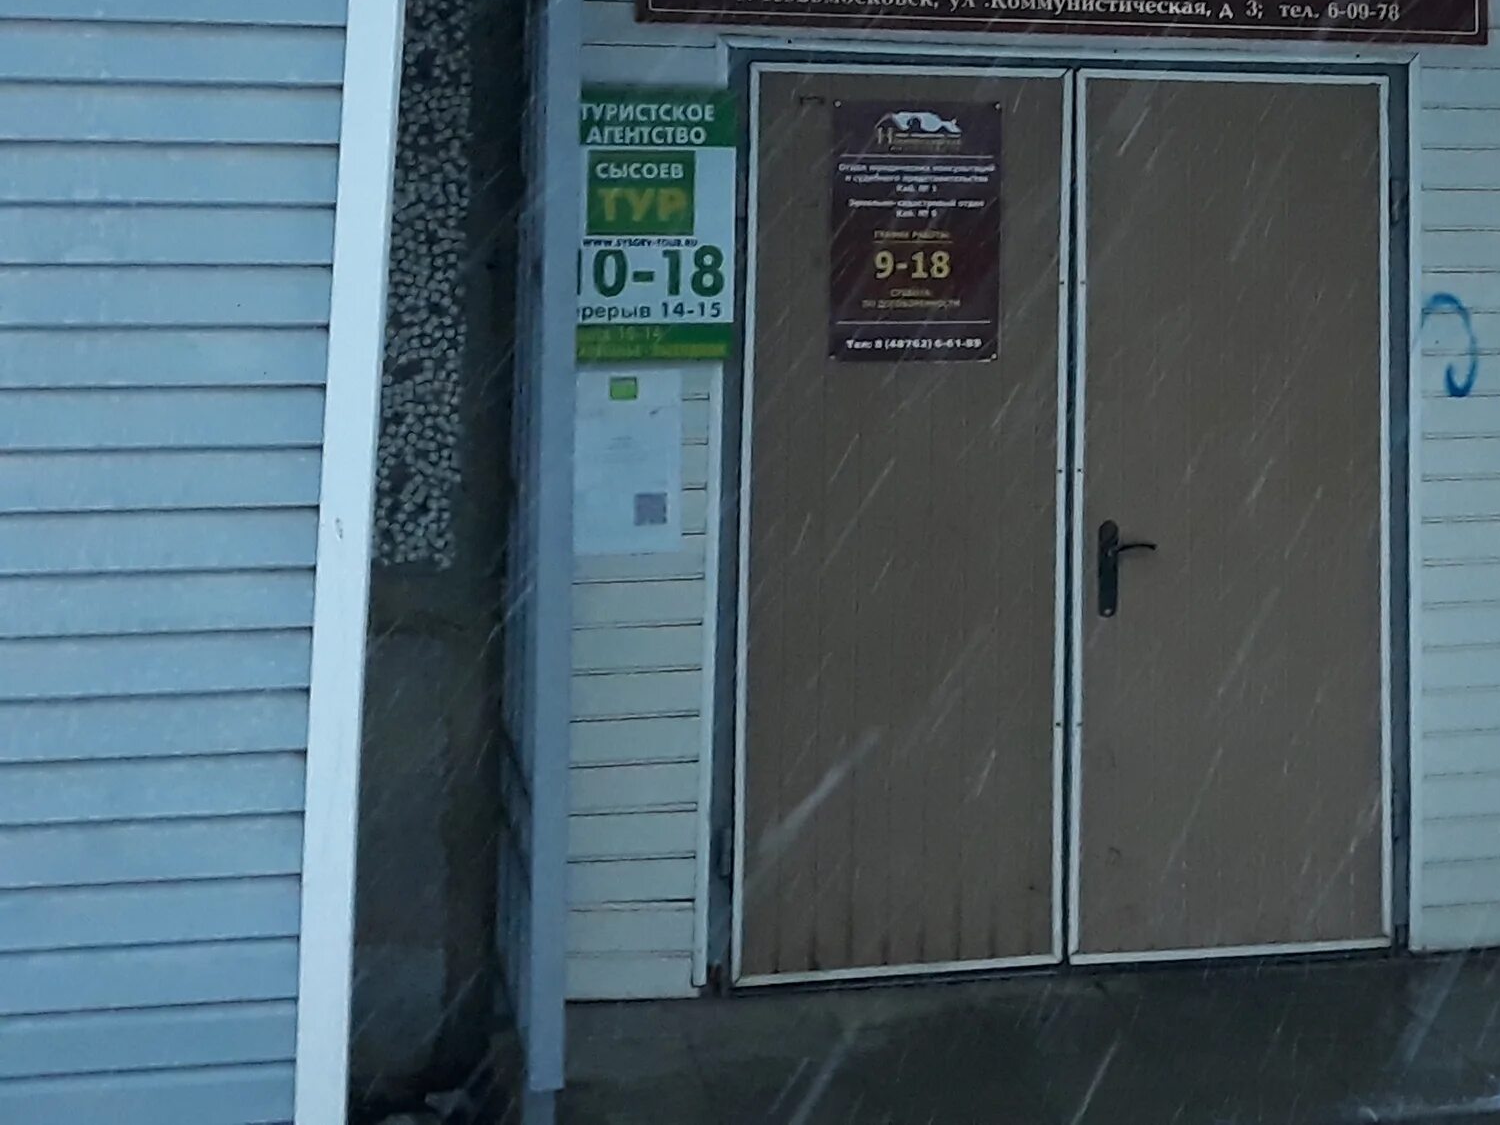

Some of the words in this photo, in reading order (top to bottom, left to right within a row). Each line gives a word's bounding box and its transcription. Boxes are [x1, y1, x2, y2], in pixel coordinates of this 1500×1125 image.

[1218, 3, 1234, 20] д
[1279, 2, 1319, 20] тел.
[1327, 3, 1400, 22] 6-09-78
[580, 103, 716, 123] ТУРИСТСКОЕ
[586, 126, 708, 145] АГЕНТСТВО
[595, 162, 685, 180] СЫСОЕВ
[597, 187, 688, 222] ТУР
[874, 250, 951, 279] 9-18
[661, 302, 722, 319] 14-15
